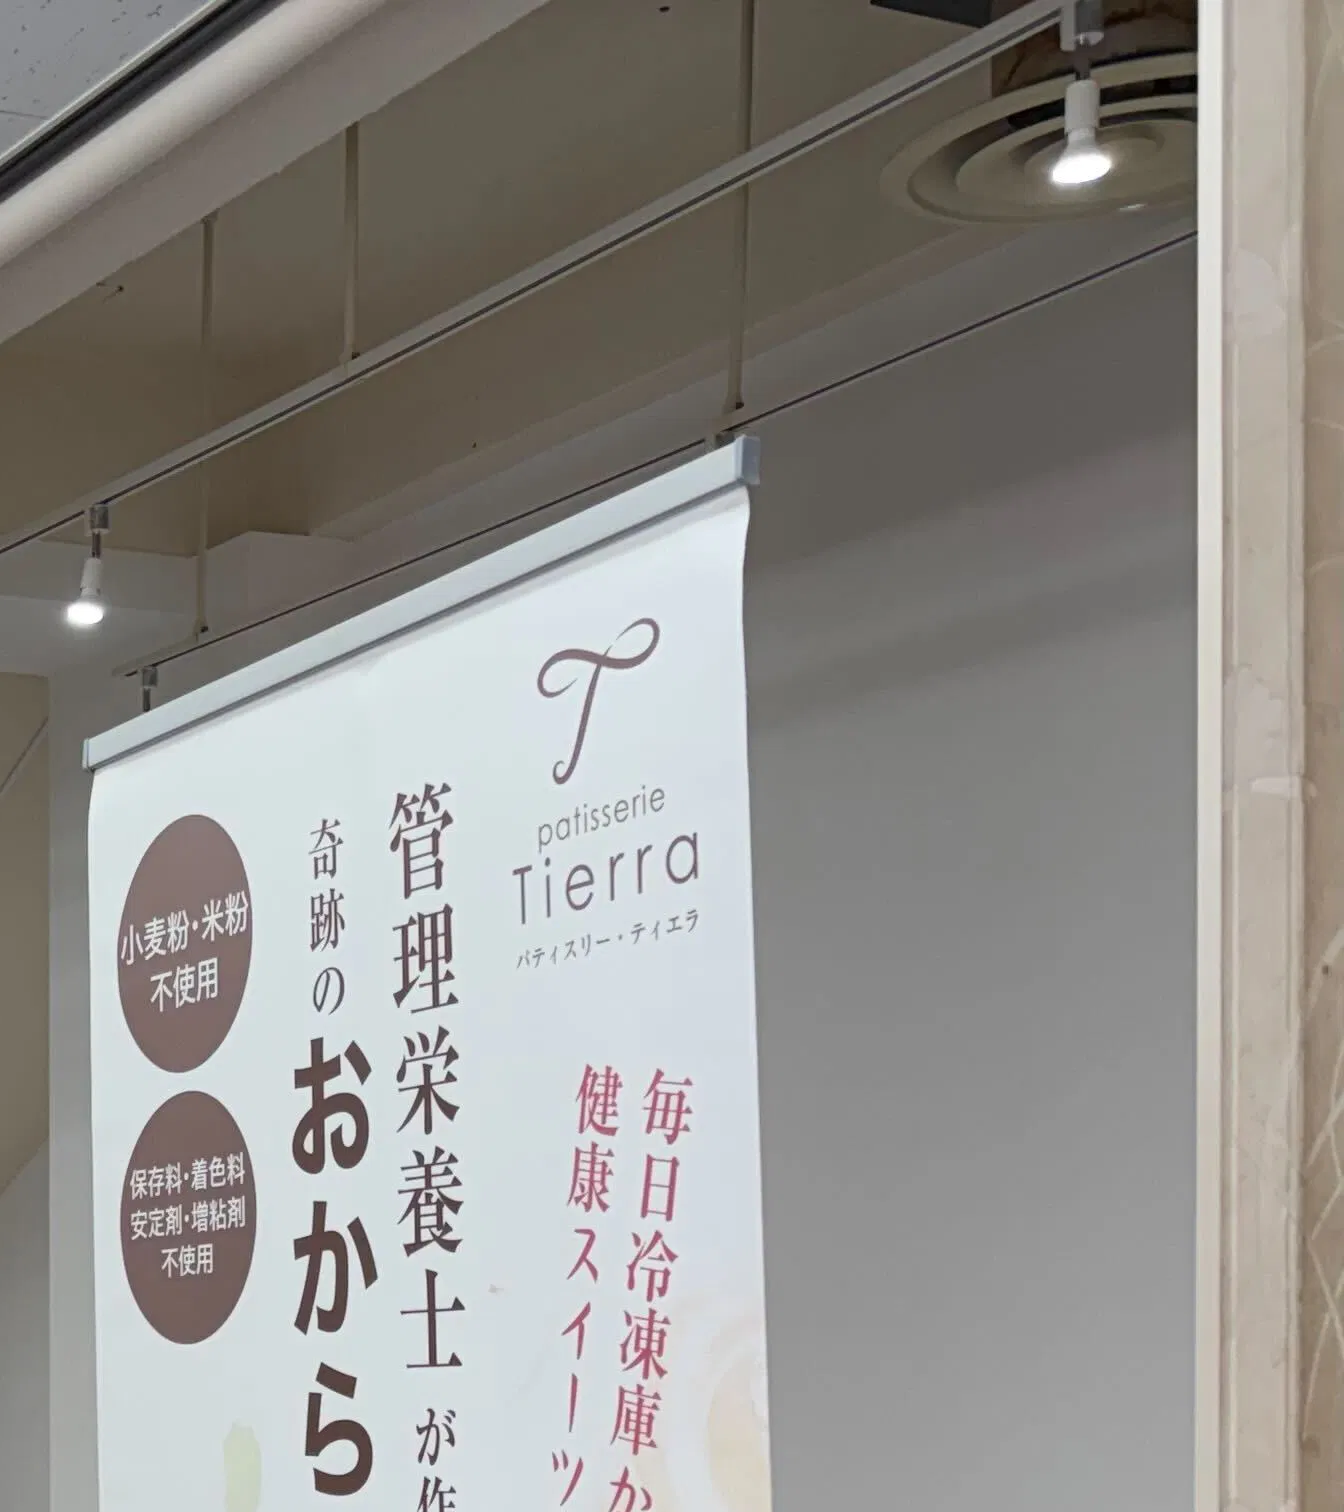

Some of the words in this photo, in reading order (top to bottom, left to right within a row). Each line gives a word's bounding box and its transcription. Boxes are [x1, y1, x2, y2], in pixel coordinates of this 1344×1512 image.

[537, 784, 666, 856] patisserie
[512, 828, 700, 926] Tierra
[120, 888, 249, 966] 小麦粉・米粉
[516, 908, 701, 971] パティスリー・ティエラ
[150, 960, 219, 1014] 不使用
[129, 1151, 245, 1200] 保存料・着色料
[130, 1190, 246, 1241] 安定剤・増粘剤
[161, 1240, 215, 1278] 不使用
